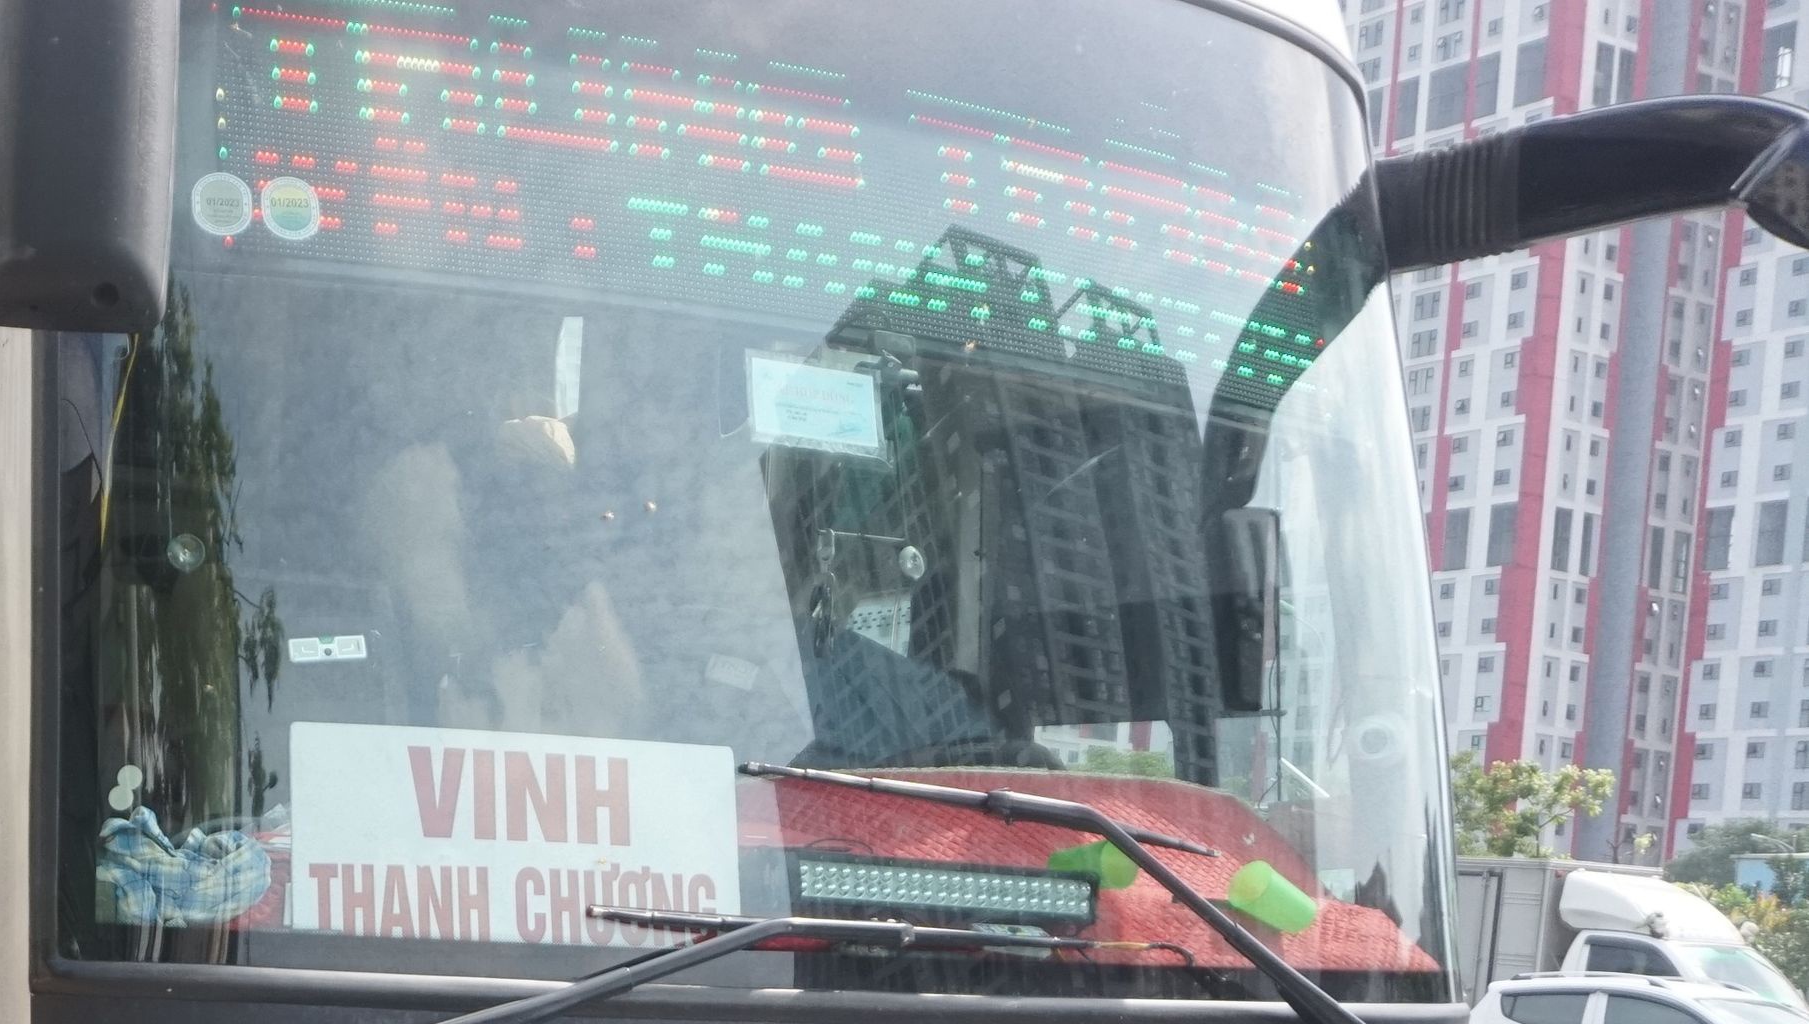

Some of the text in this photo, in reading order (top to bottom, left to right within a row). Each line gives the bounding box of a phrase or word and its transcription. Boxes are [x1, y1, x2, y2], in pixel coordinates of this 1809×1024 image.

[206, 196, 240, 208] 01/2023
[270, 196, 310, 209] 01/2023
[407, 745, 631, 846] VINH
[308, 862, 491, 943] THANH
